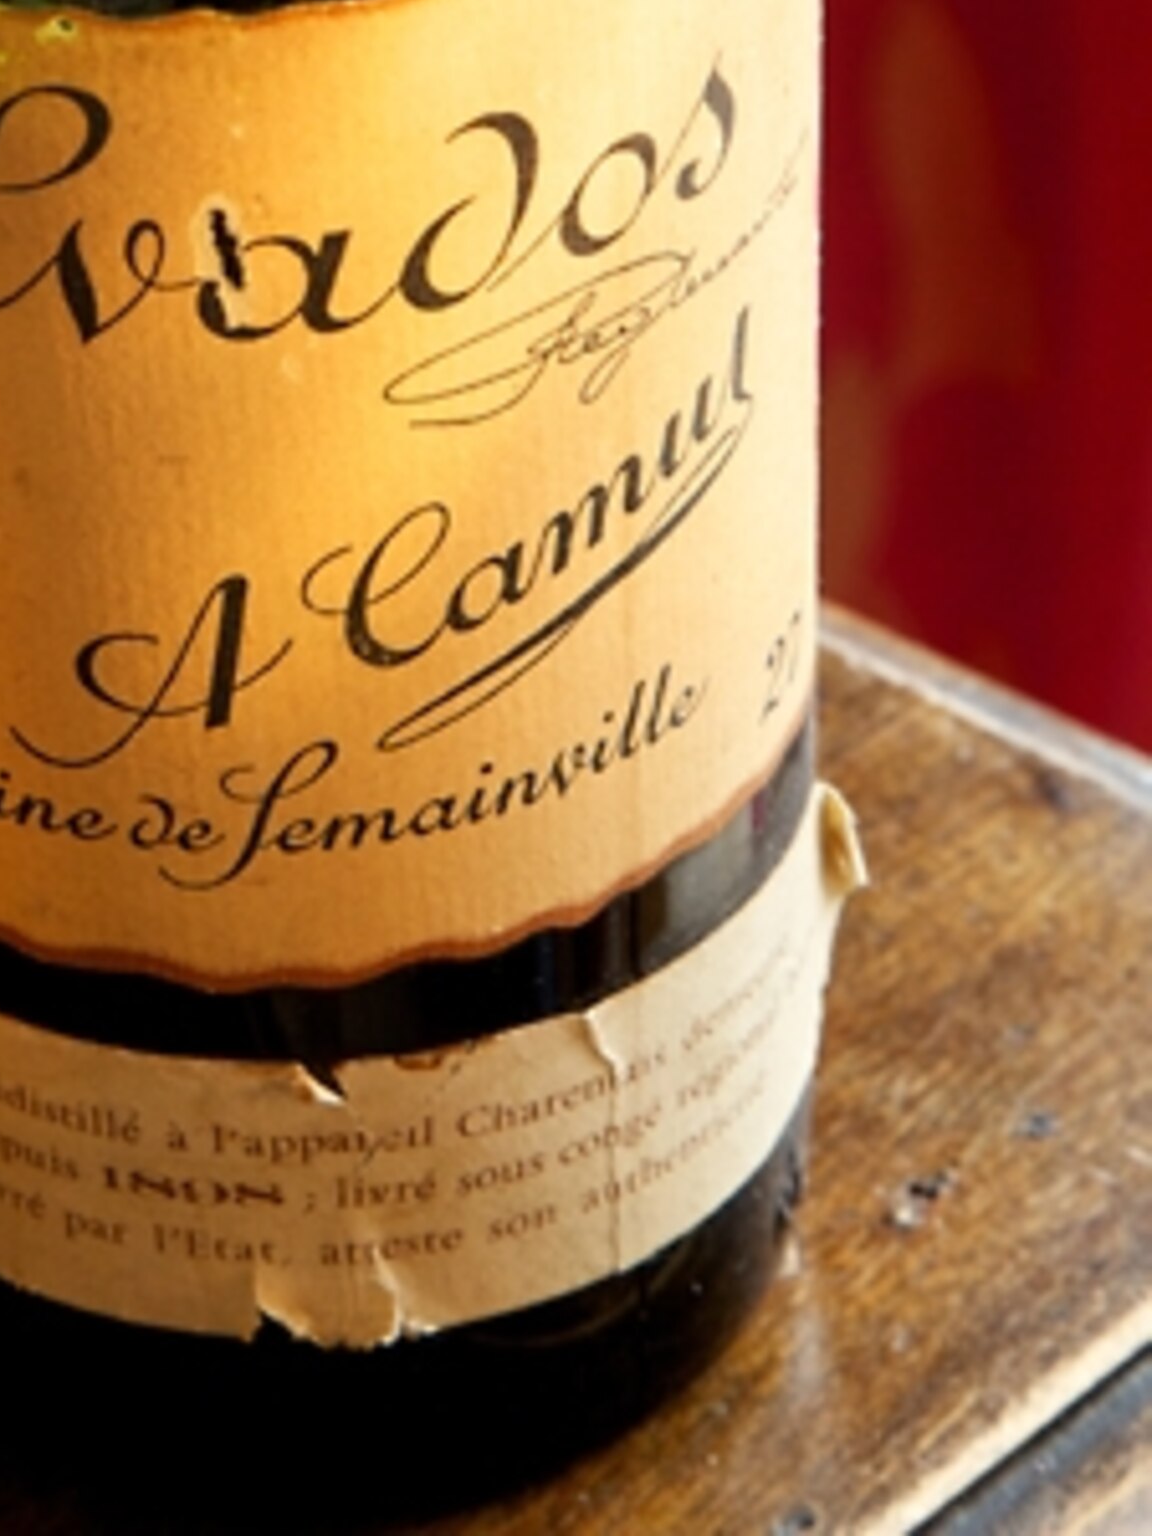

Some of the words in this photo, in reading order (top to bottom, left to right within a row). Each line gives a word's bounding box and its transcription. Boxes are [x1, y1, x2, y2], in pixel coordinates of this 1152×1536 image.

[129, 792, 226, 854] de
[457, 1150, 547, 1197] sous
[64, 1210, 129, 1246] par
[489, 1203, 559, 1243] son
